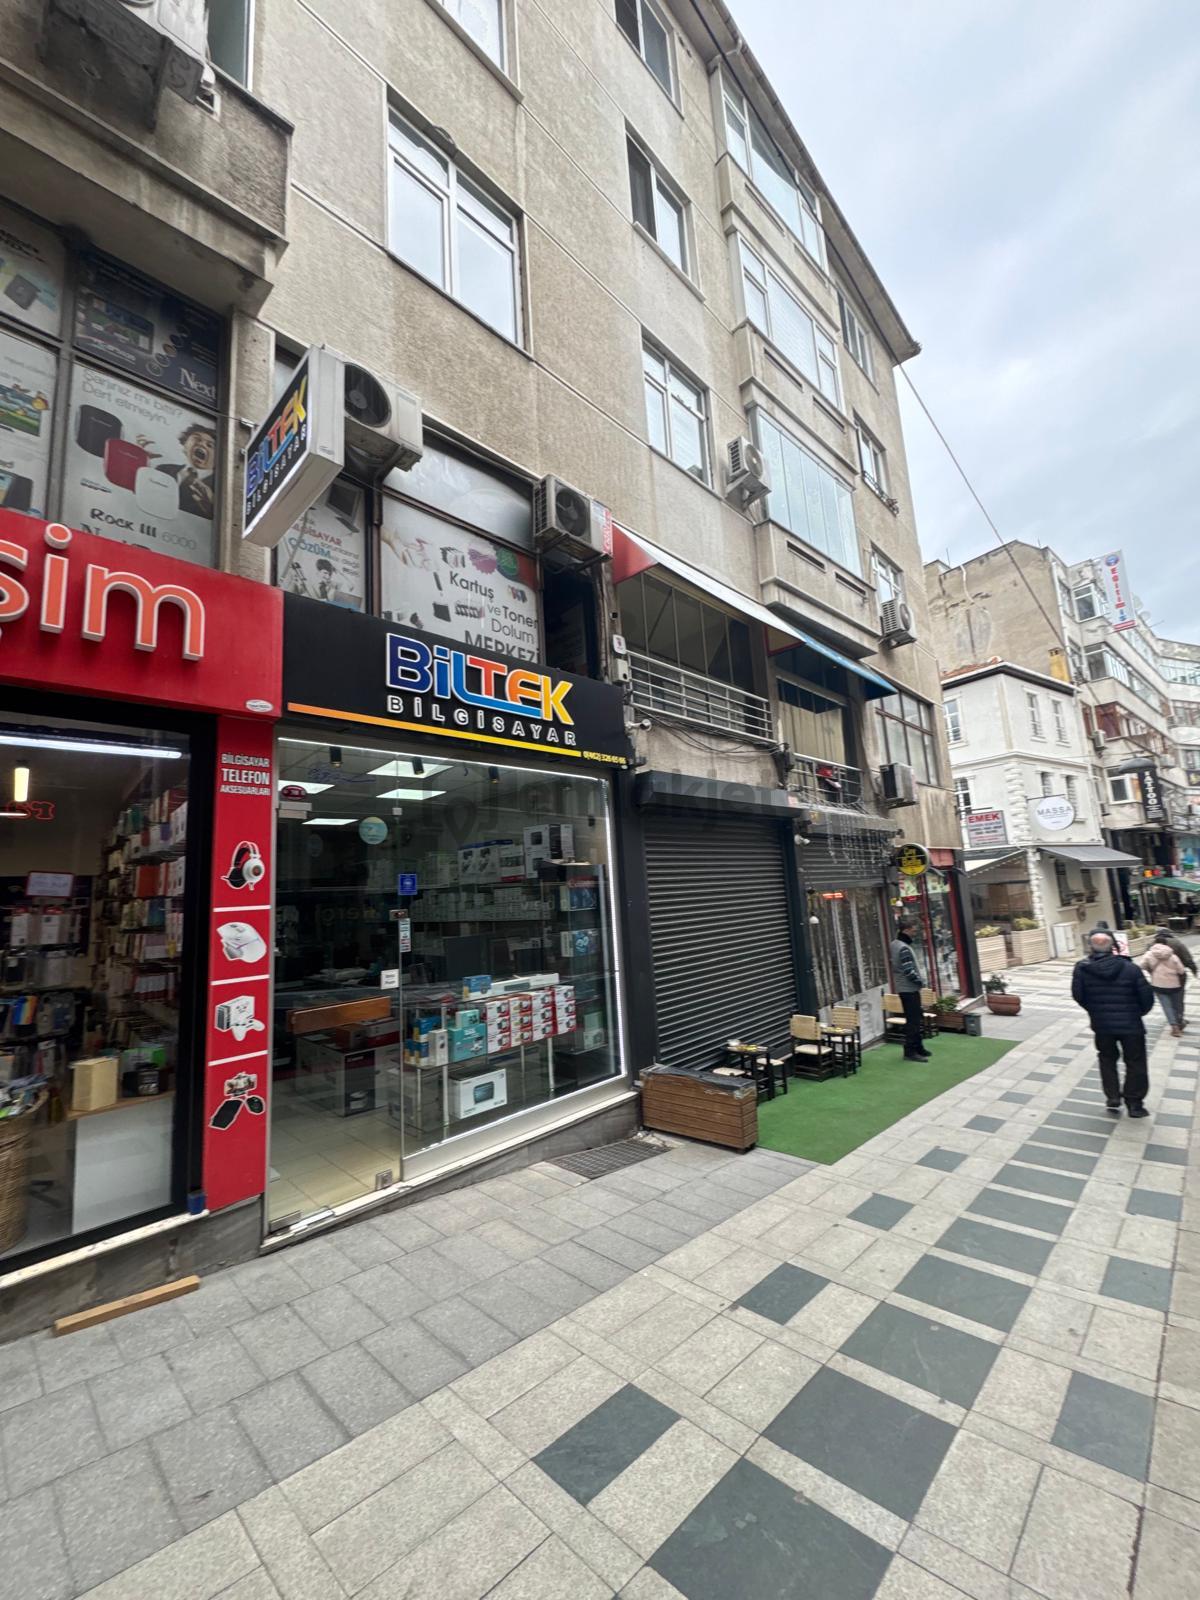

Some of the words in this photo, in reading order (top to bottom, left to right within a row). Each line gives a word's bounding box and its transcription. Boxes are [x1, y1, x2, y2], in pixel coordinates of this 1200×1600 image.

[450, 571, 495, 600] Kartuş
[487, 604, 501, 616] ve
[502, 605, 539, 629] Toner
[491, 618, 535, 645] Dolum
[386, 695, 578, 747] BİLGİSAYAR
[221, 751, 271, 768] BİLGİSAYAR
[220, 768, 270, 785] TELEFON
[967, 813, 1001, 824] EMEK
[1036, 805, 1073, 816] MASSA
